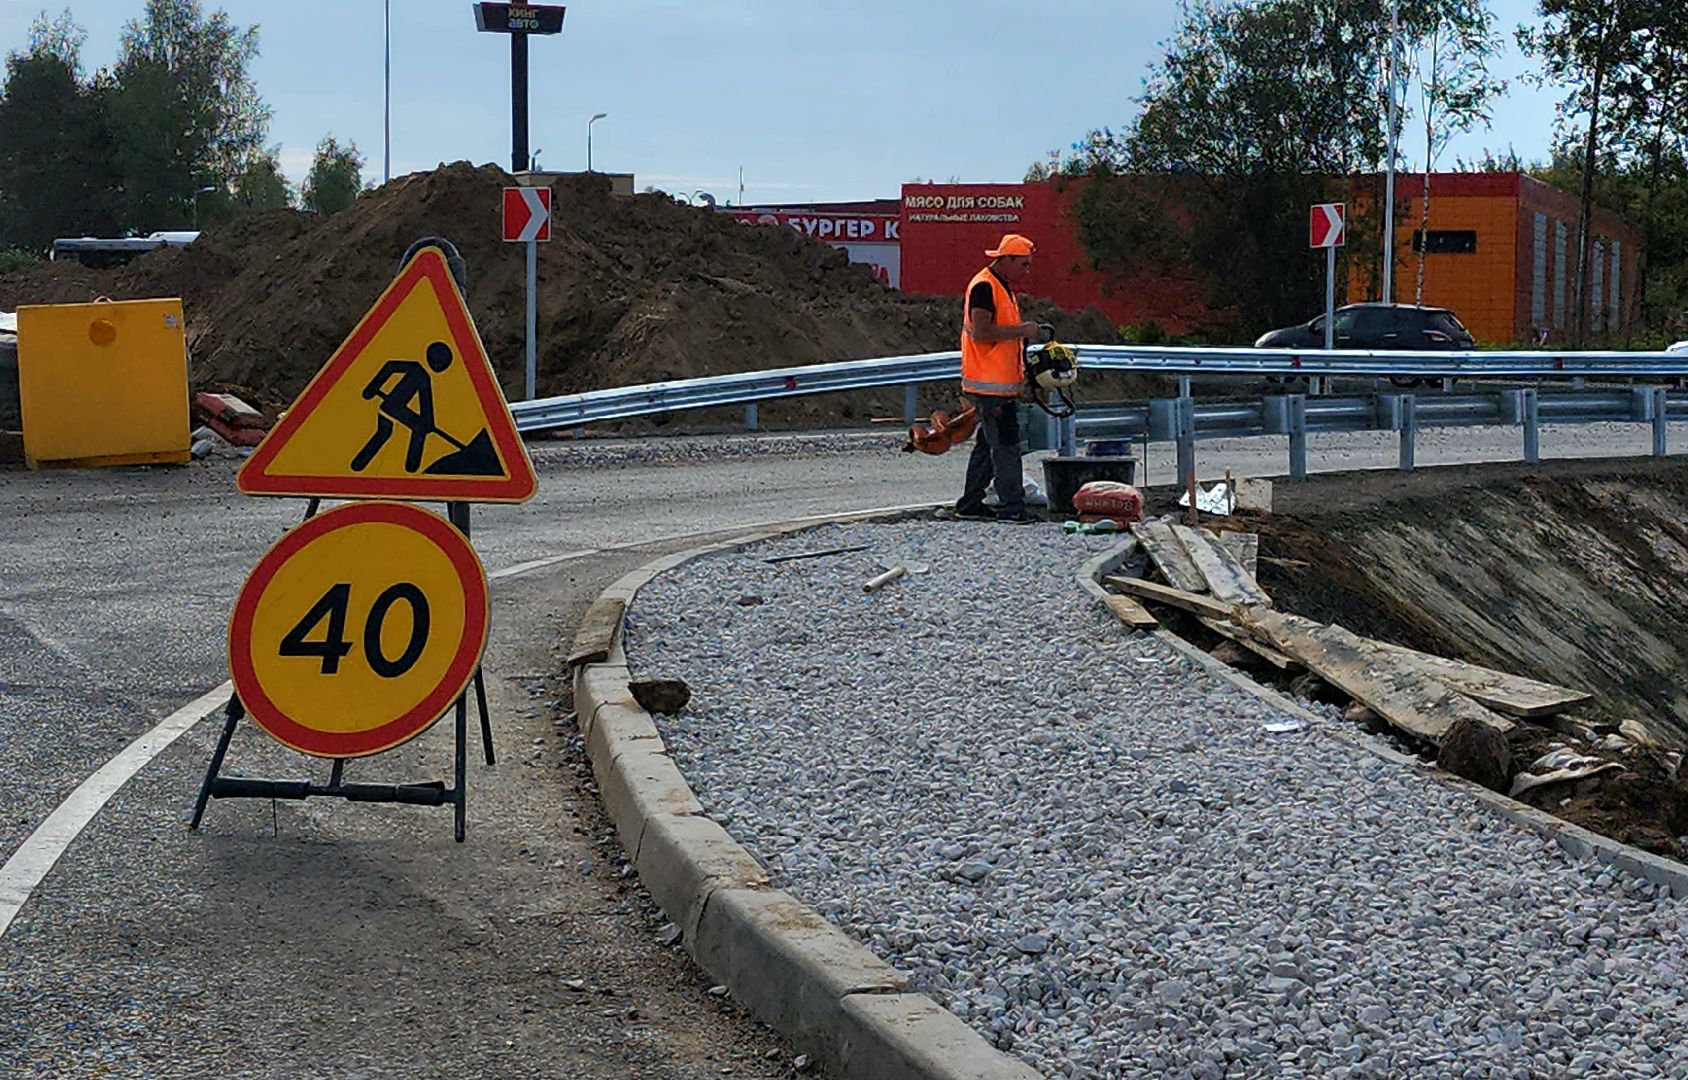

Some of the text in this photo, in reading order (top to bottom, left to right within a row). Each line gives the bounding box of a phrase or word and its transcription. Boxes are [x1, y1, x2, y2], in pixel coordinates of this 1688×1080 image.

[905, 196, 1024, 209] МЯСО ДЛЯ СОБАК
[279, 582, 430, 678] 40
